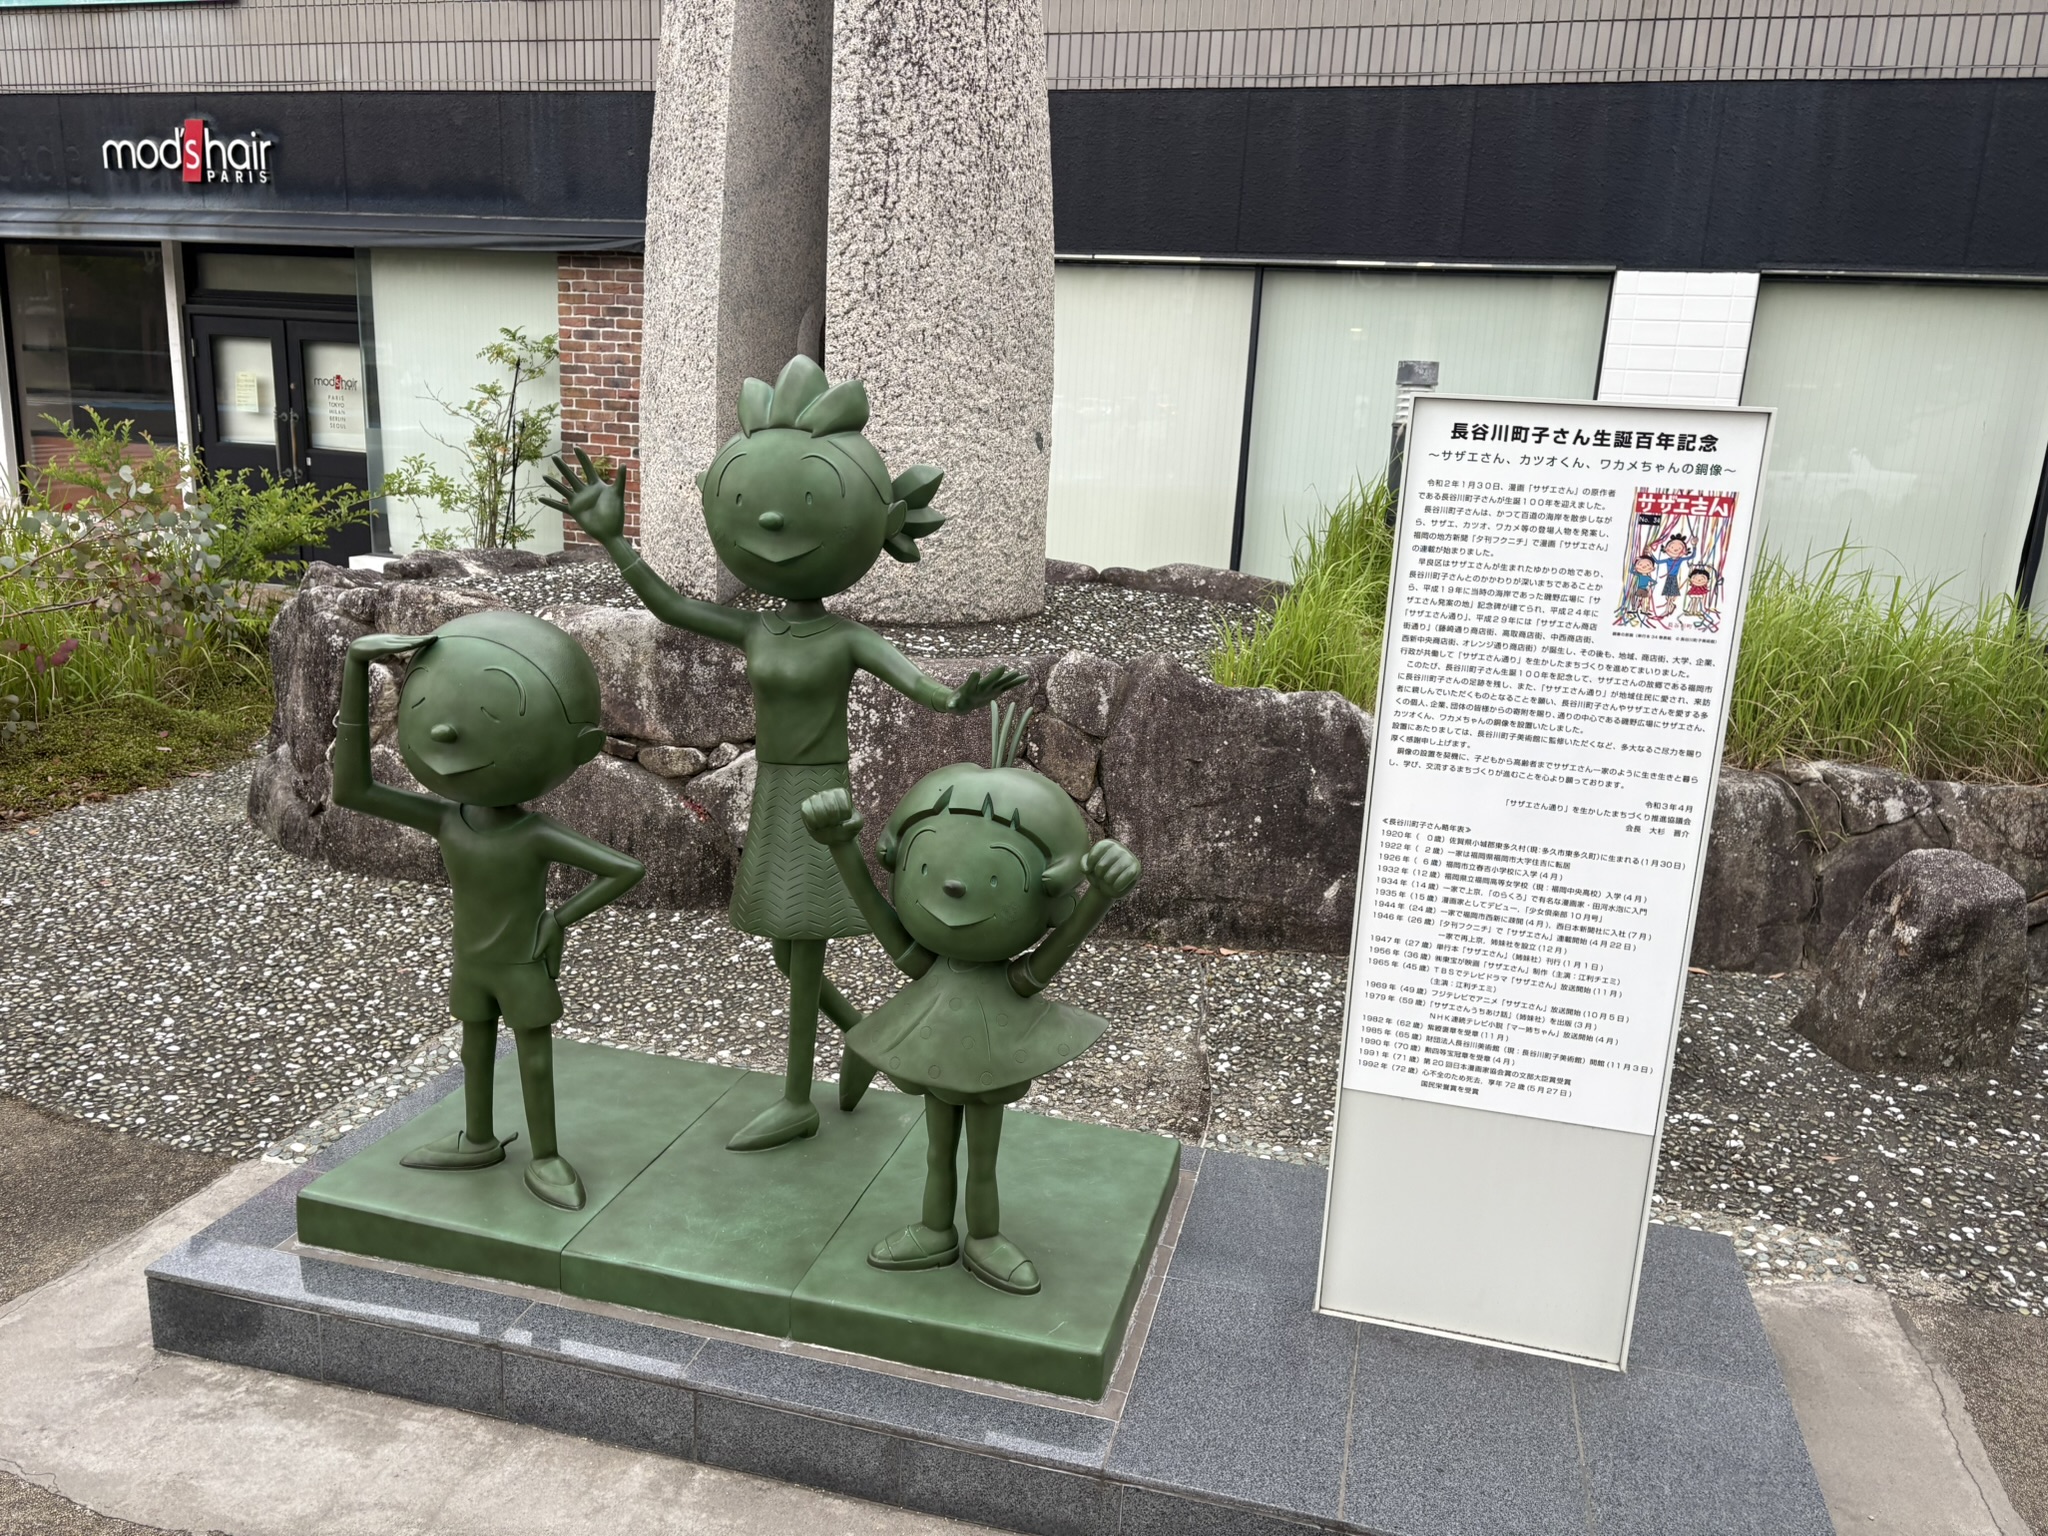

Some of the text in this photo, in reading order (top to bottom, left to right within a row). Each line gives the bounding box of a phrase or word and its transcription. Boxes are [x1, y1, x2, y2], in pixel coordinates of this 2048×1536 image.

[102, 127, 200, 169] mod's
[204, 127, 272, 170] hair
[207, 170, 269, 184] PARIS
[1449, 421, 1719, 453] 長谷川町子さん生誕百年記念
[1423, 504, 1613, 524] 長谷川町子さんは、かつて百道の海岸を散歩しなが
[1638, 494, 1729, 517] サザエさん
[1414, 517, 1609, 538] ら、サザエ、カツオ、ワカメ等の登場人物を発案し、
[1411, 544, 1494, 557] の連載が始まりました。
[1418, 557, 1603, 578] 早良区はサザエさんが生まれたゆかりの地であり、
[1408, 569, 1603, 591] 長谷川町子さんとのかかわりが深いまちであることか
[1393, 709, 1583, 734] カツオくん、ワカメちゃんの銅像を設置いたしました。
[1389, 733, 1470, 749] 厚く感謝申し上げます。
[1625, 824, 1641, 832] 会長
[1648, 826, 1665, 835] 大杉
